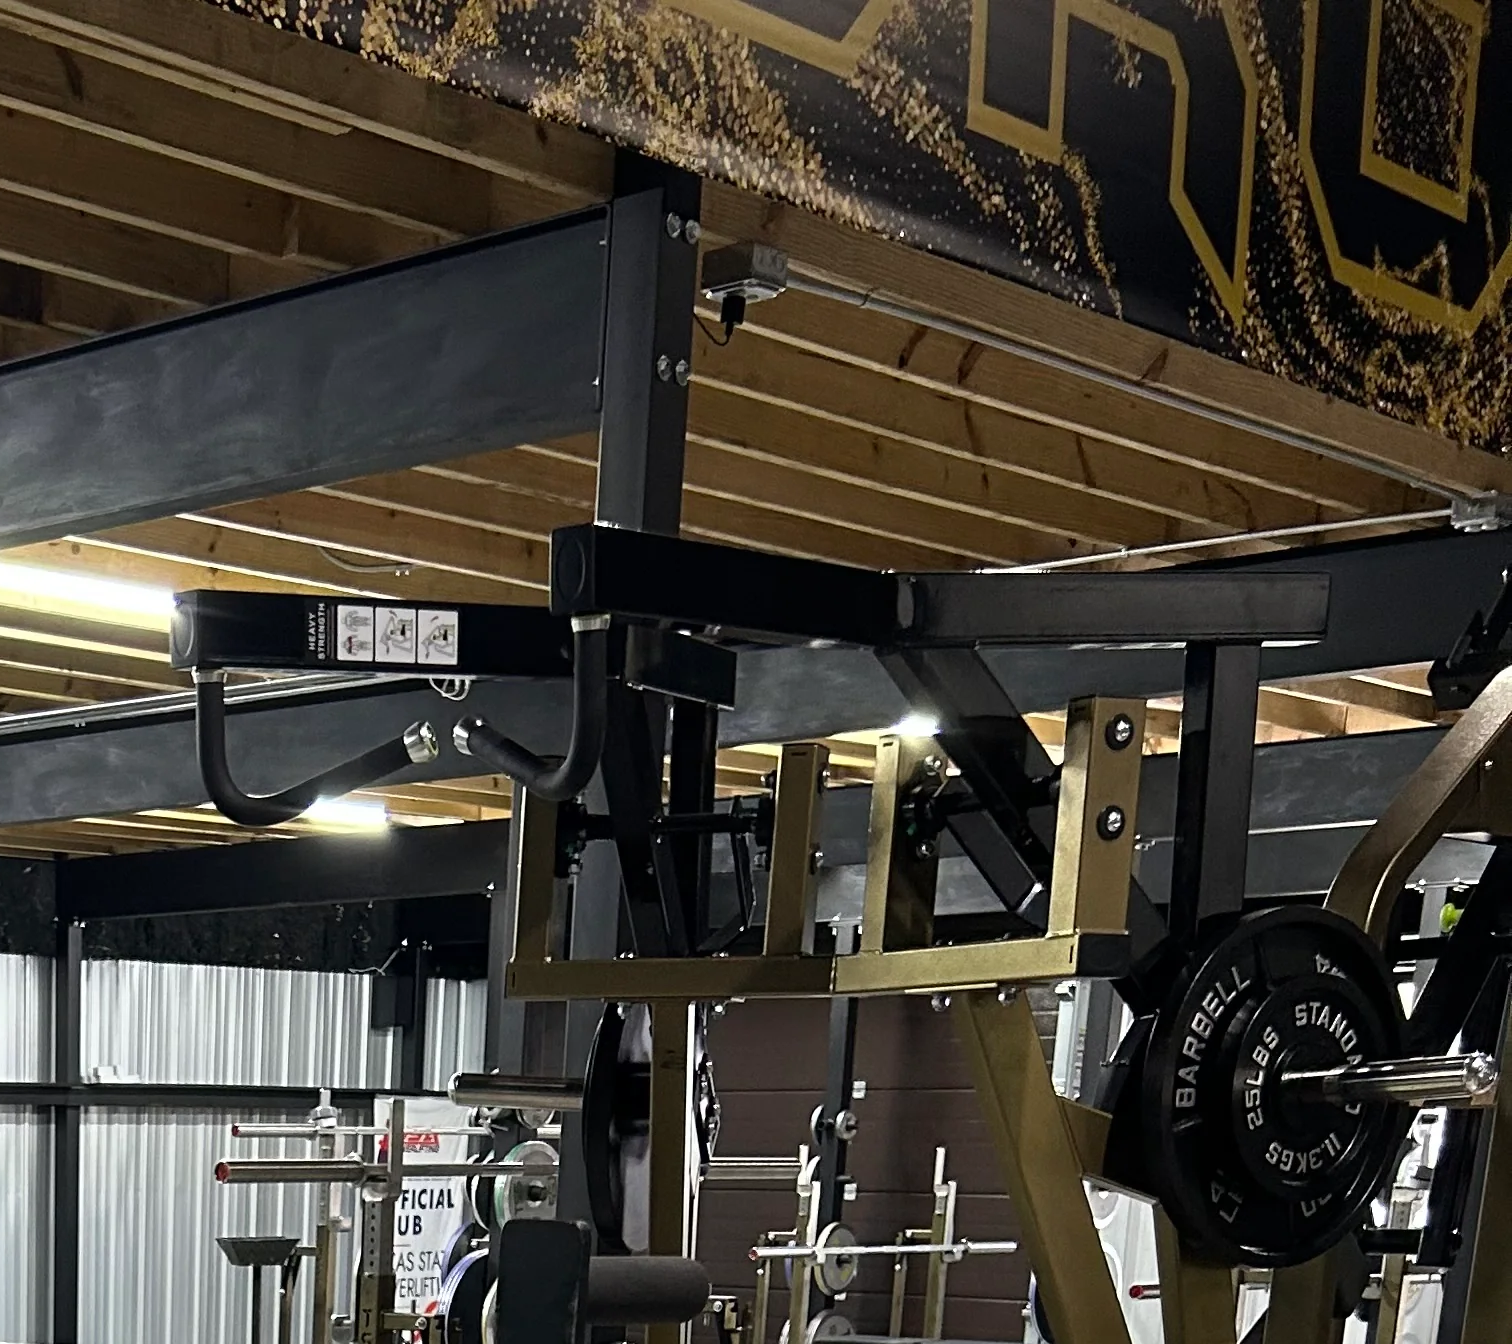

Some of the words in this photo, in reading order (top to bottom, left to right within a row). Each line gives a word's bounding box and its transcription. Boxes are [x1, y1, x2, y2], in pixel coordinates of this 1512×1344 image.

[308, 612, 316, 651] HEAVY
[318, 603, 326, 660] STRENGTH
[1175, 966, 1251, 1108] BARBELL
[1245, 1026, 1280, 1130] 25LBS
[1265, 1132, 1342, 1174] 11.3KGS
[394, 1251, 415, 1272] AS
